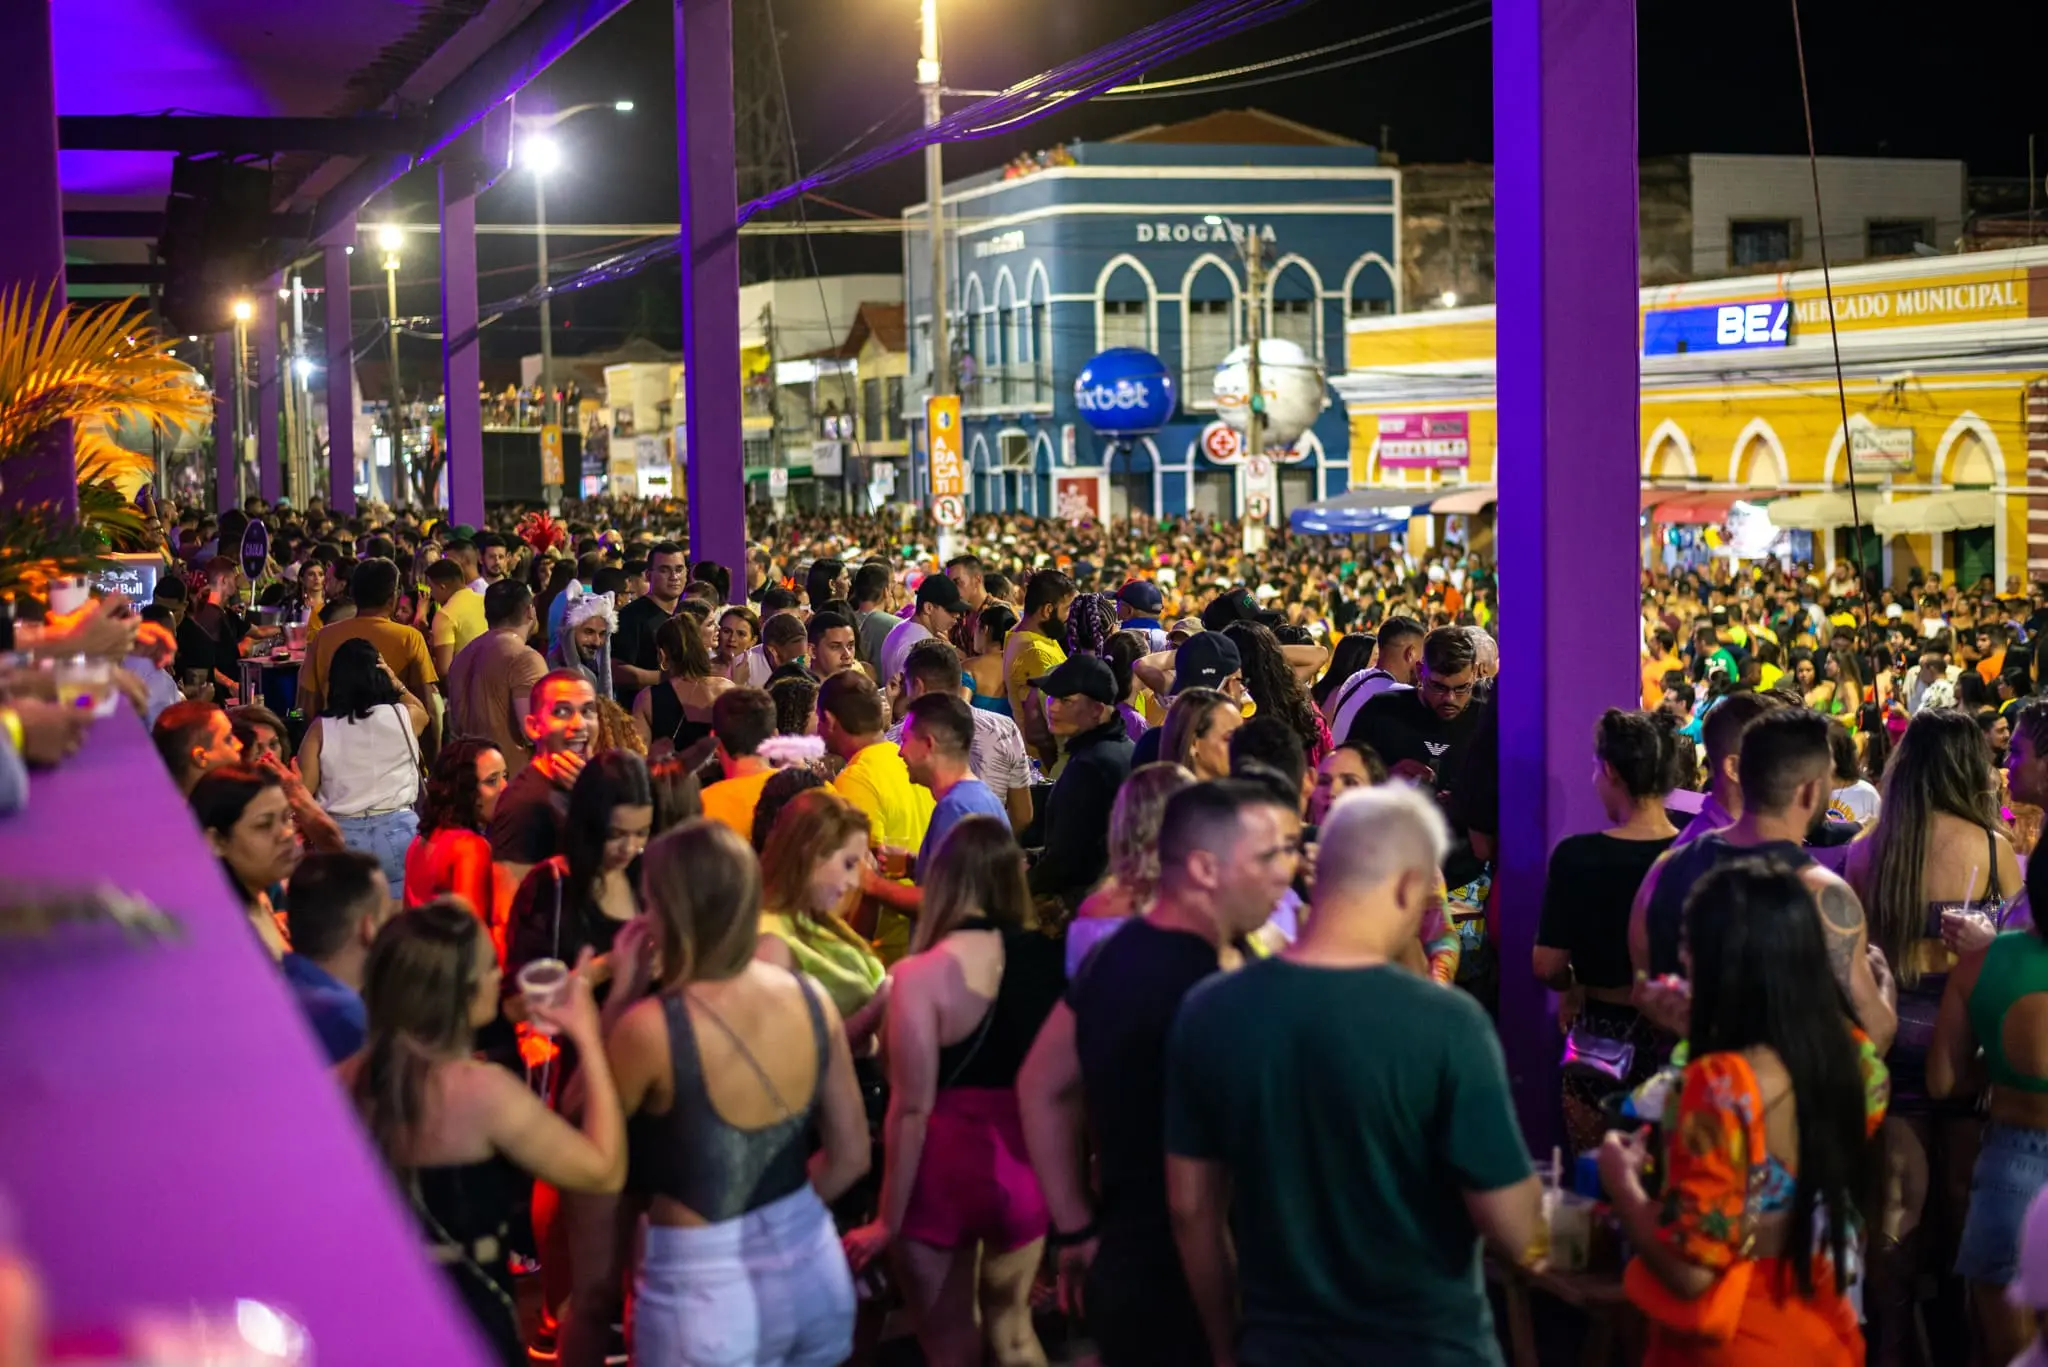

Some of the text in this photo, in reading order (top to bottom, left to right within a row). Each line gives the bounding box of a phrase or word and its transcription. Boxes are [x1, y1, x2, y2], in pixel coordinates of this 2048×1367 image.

[1136, 223, 1277, 242] DROGARIA
[1793, 281, 2018, 324] MERCADO MUNICIPAL
[120, 582, 143, 595] Bull
